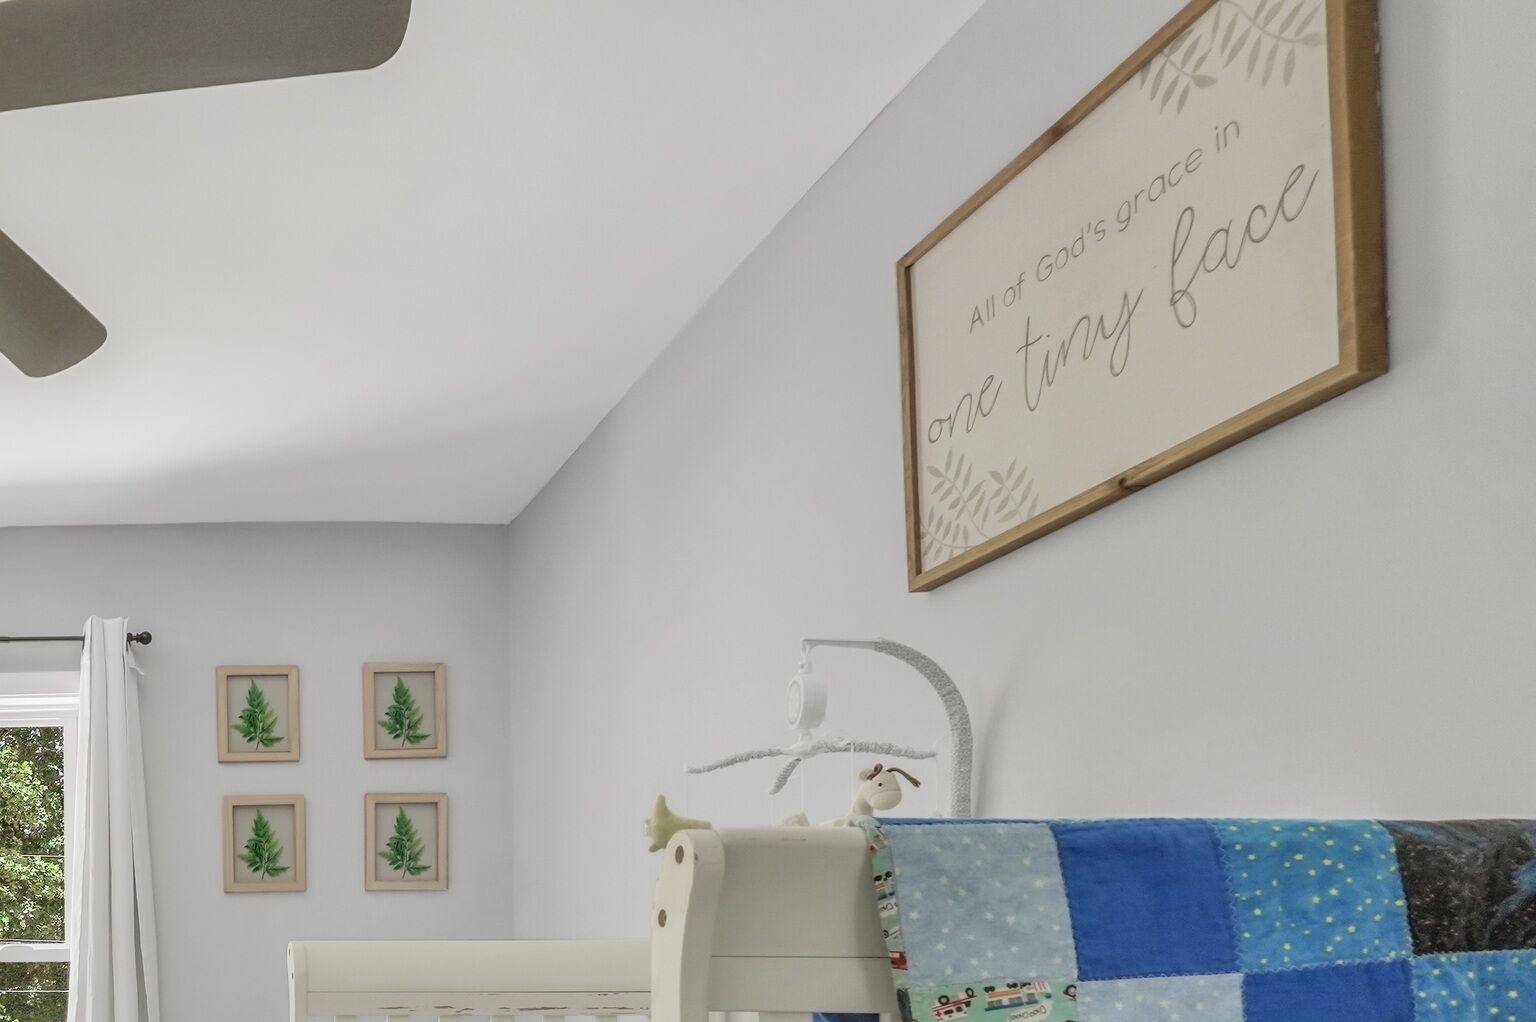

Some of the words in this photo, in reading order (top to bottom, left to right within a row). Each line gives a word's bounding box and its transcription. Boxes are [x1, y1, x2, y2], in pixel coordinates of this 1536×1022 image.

[927, 374, 1003, 444] one
[1016, 288, 1144, 412] tiny
[1169, 164, 1320, 328] face
[969, 298, 995, 333] All
[1003, 273, 1027, 308] of
[1035, 222, 1107, 283] God's
[1116, 148, 1202, 234] grace
[1215, 120, 1241, 153] in
